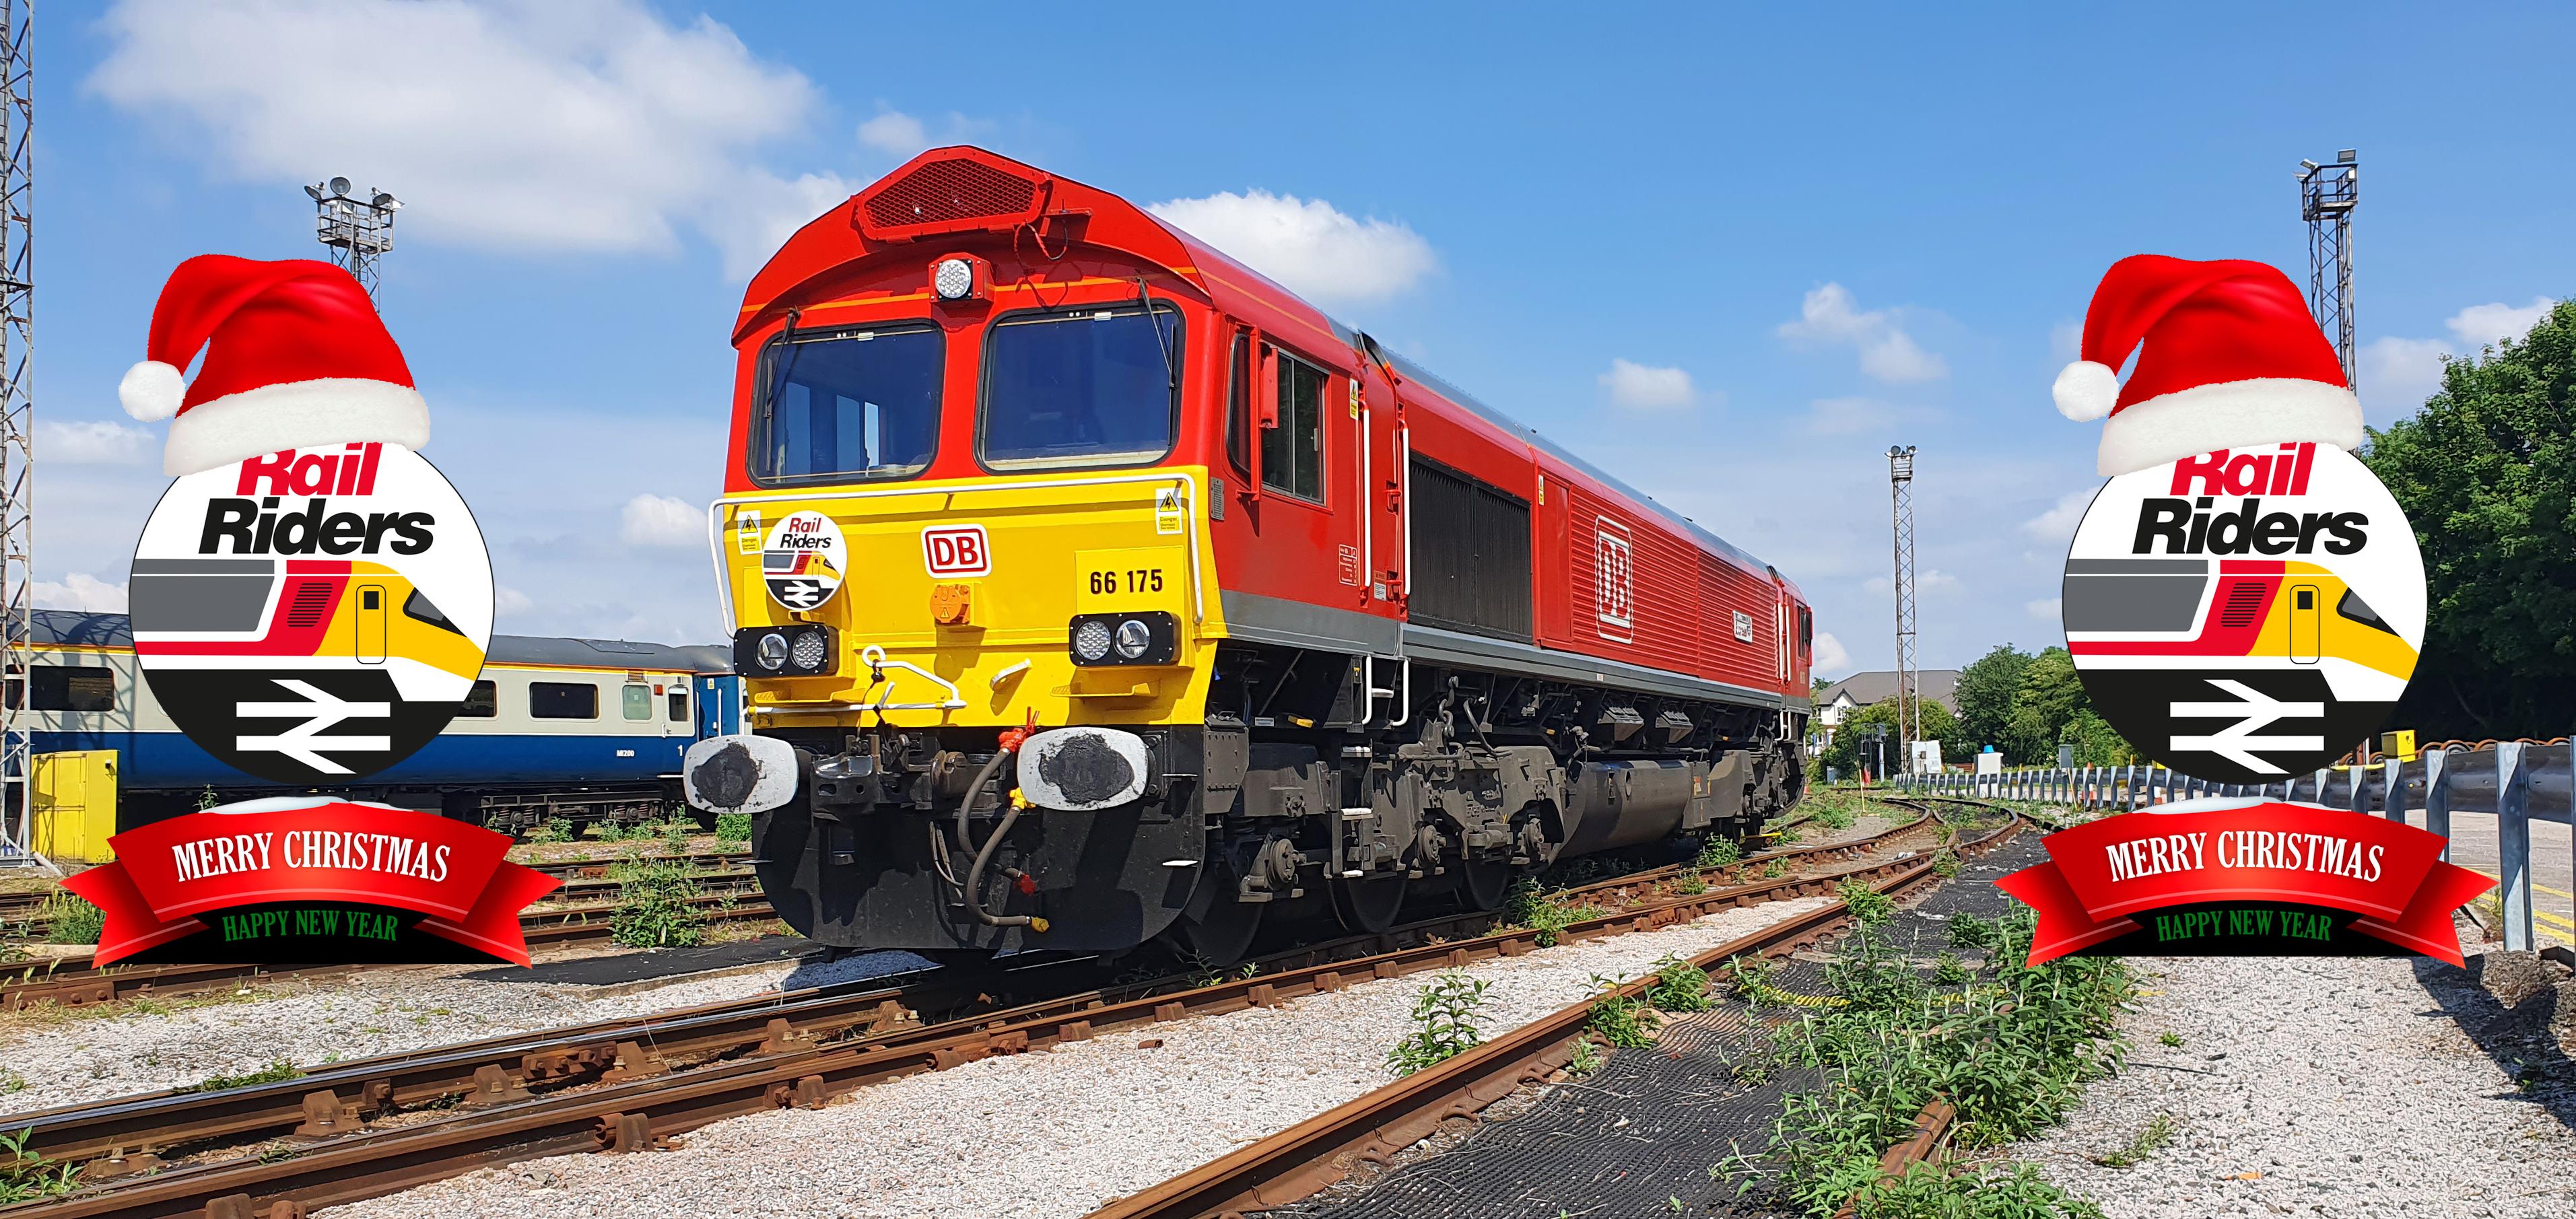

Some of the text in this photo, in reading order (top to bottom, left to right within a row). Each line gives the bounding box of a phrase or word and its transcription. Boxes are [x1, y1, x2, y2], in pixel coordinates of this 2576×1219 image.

[788, 518, 822, 533] Rail
[780, 534, 832, 549] Riders
[933, 536, 978, 566] DB
[1090, 569, 1163, 594] 66 175
[1600, 540, 1629, 619] DB
[677, 744, 683, 757] 1
